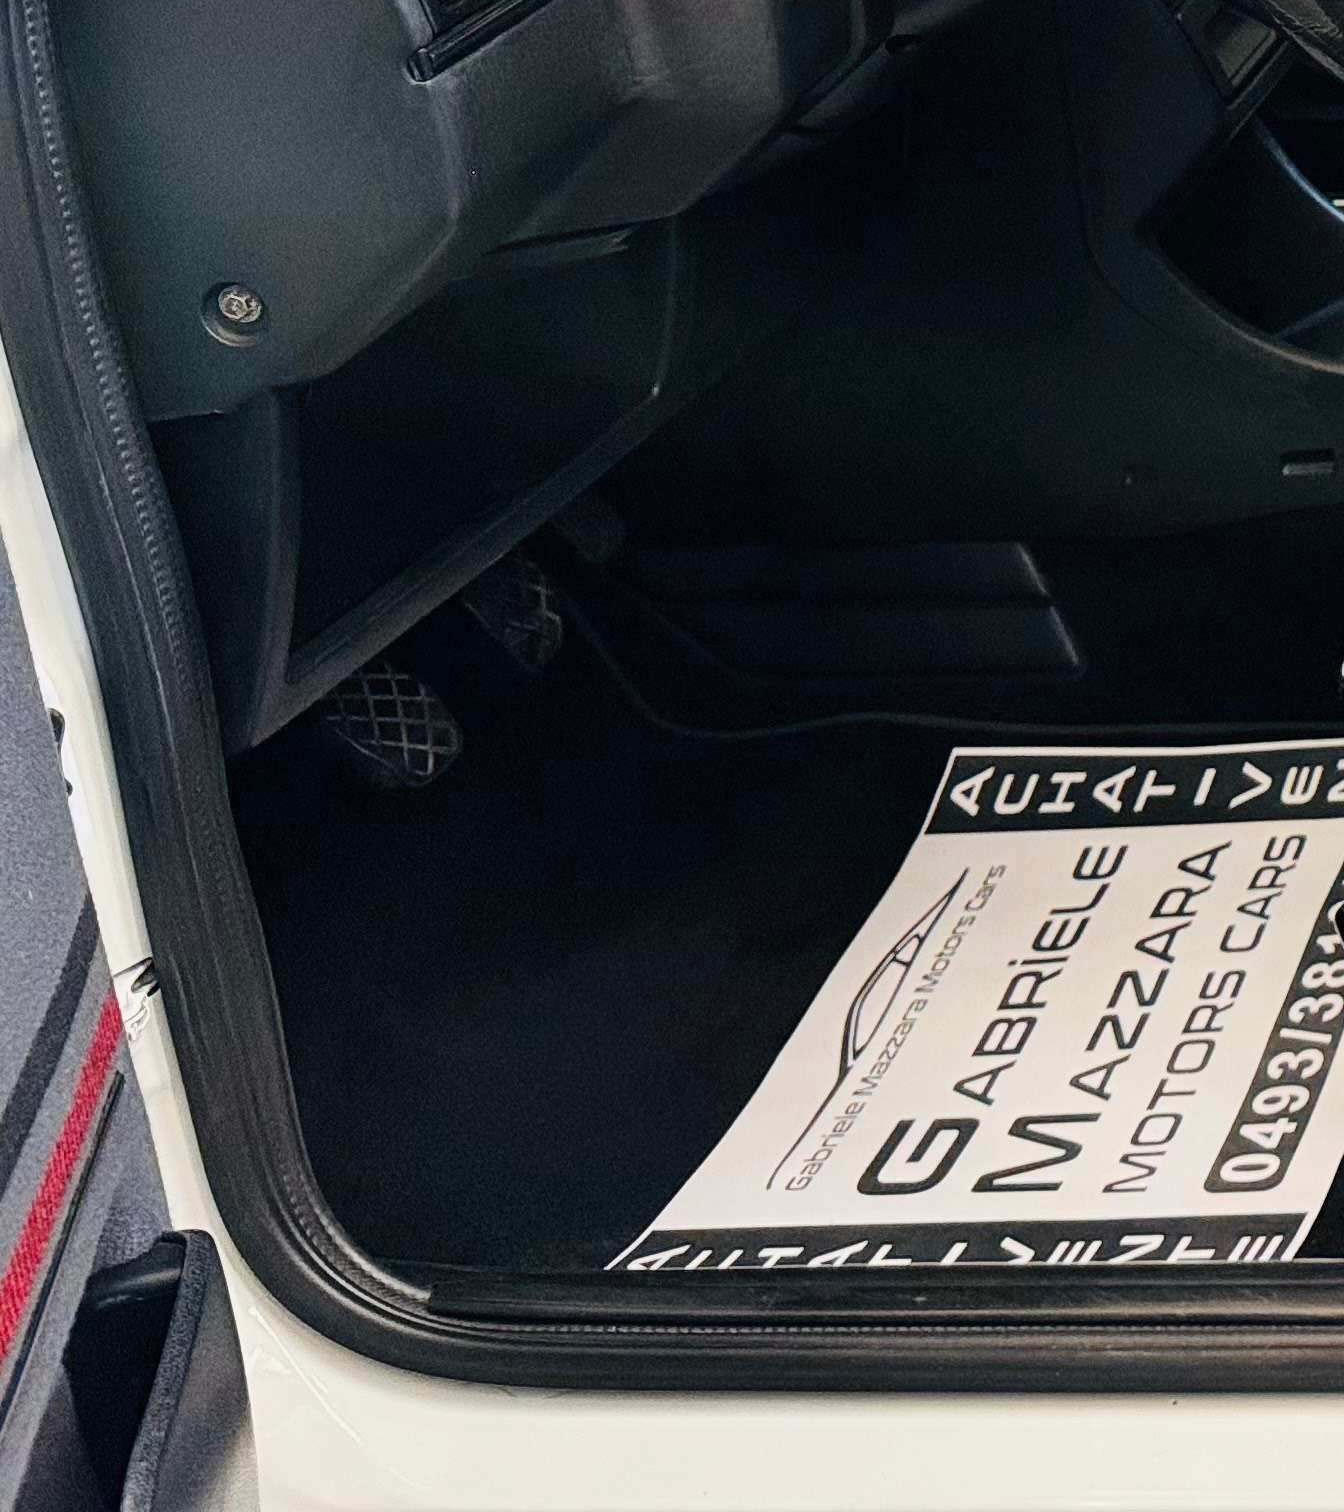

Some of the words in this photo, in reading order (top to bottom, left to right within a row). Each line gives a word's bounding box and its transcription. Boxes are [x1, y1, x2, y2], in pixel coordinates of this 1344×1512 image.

[785, 1101, 866, 1191] Gabriele
[853, 998, 929, 1097] Mazzara
[914, 915, 977, 994] Motors
[964, 864, 1007, 916] Cars
[971, 841, 1232, 1193] MAZZARA
[1102, 969, 1247, 1193] MOTORS
[1219, 835, 1307, 953] CARS
